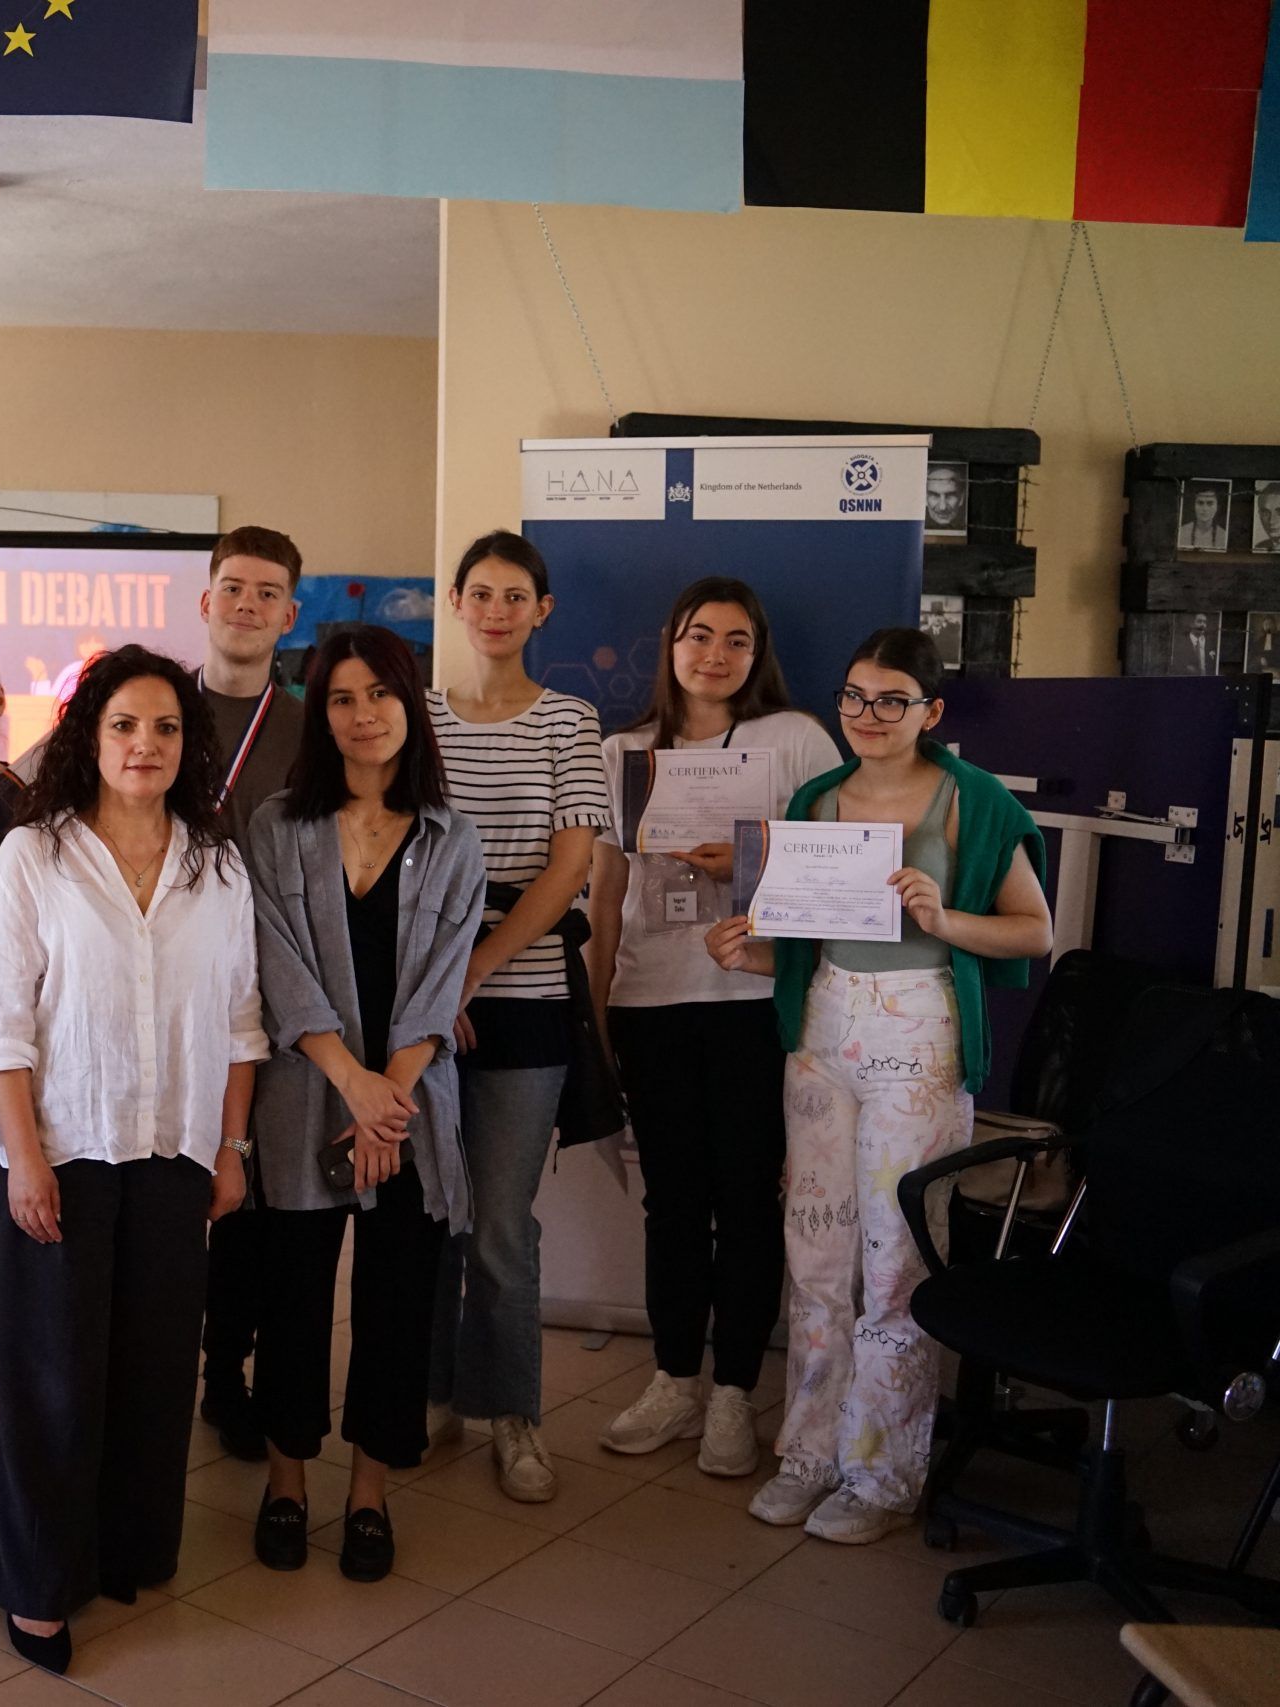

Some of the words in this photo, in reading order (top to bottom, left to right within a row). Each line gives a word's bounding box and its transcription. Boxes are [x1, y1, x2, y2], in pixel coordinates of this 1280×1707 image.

[699, 482, 733, 493] Kingdom
[734, 482, 744, 491] of
[744, 482, 757, 491] the
[757, 482, 803, 491] Netherlands
[839, 498, 882, 513] QSNNN
[20, 570, 172, 630] DEBATIT
[783, 843, 864, 855] CERTIFIKATË
